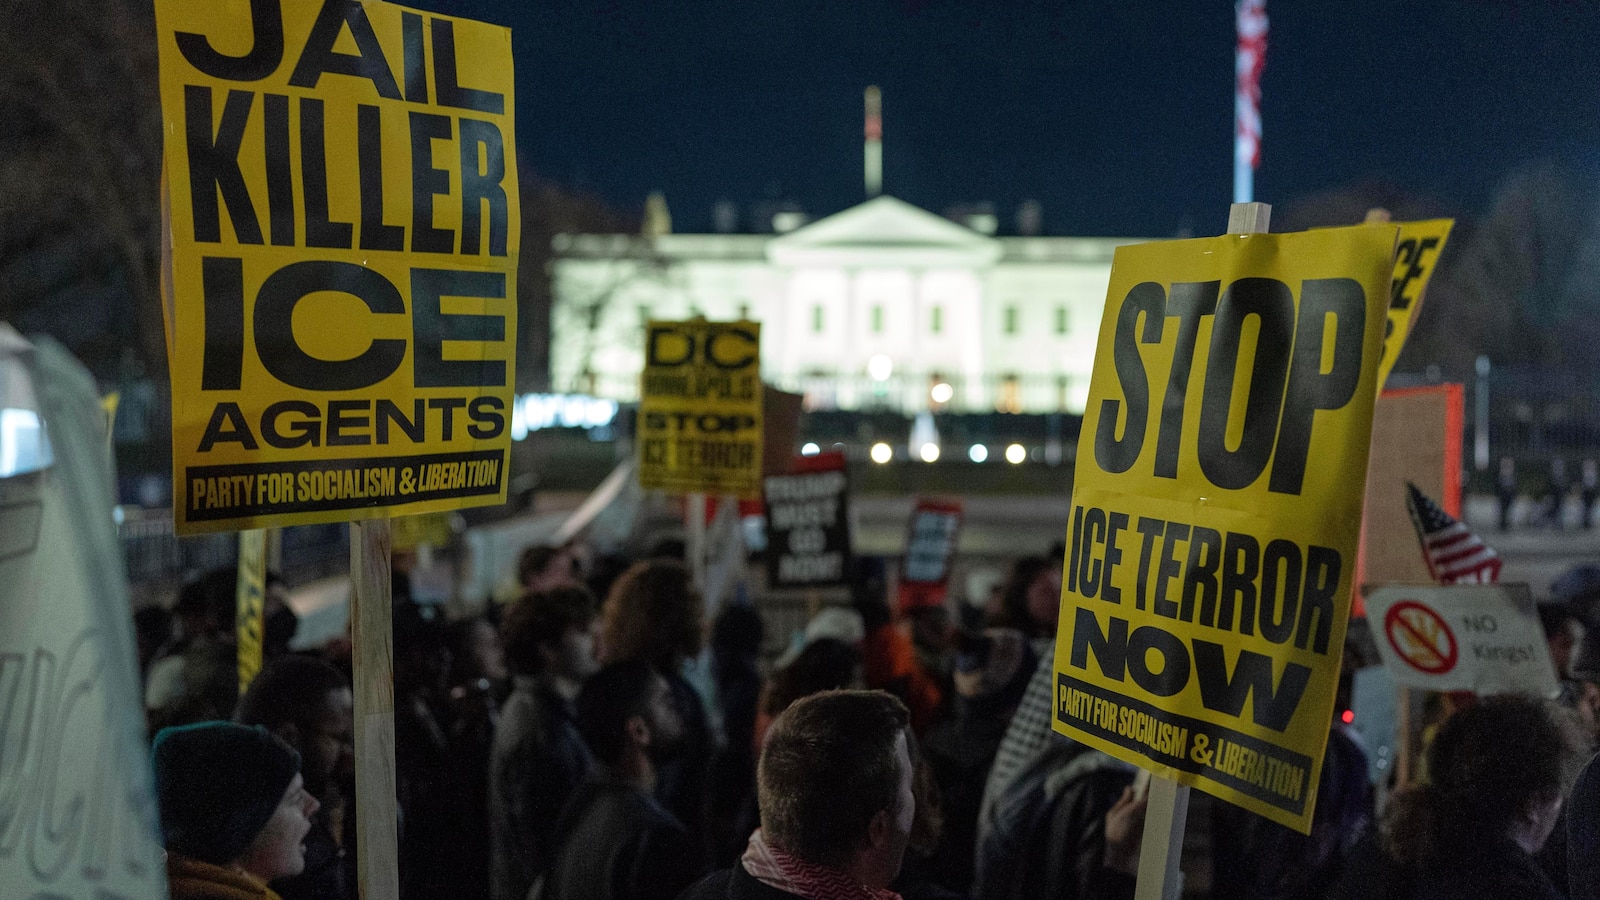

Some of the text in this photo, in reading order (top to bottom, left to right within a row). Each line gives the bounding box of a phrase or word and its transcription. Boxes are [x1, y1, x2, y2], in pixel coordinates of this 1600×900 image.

[174, 0, 505, 115] JAIL
[184, 85, 508, 257] KILLER
[201, 256, 507, 391] ICE
[650, 328, 756, 369] DC
[197, 396, 505, 452] AGENTS
[644, 412, 756, 433] STOP
[1094, 277, 1367, 495] STOP
[192, 459, 500, 511] PARTY FOR SOCIALISM & LIBERATION
[1068, 506, 1342, 656] ICE TERROR
[1462, 614, 1498, 633] NO
[1070, 606, 1313, 733] NOW
[1472, 643, 1537, 665] Kings!
[1059, 684, 1305, 801] PARTY FOR SOCIALISM & LIBERATION
